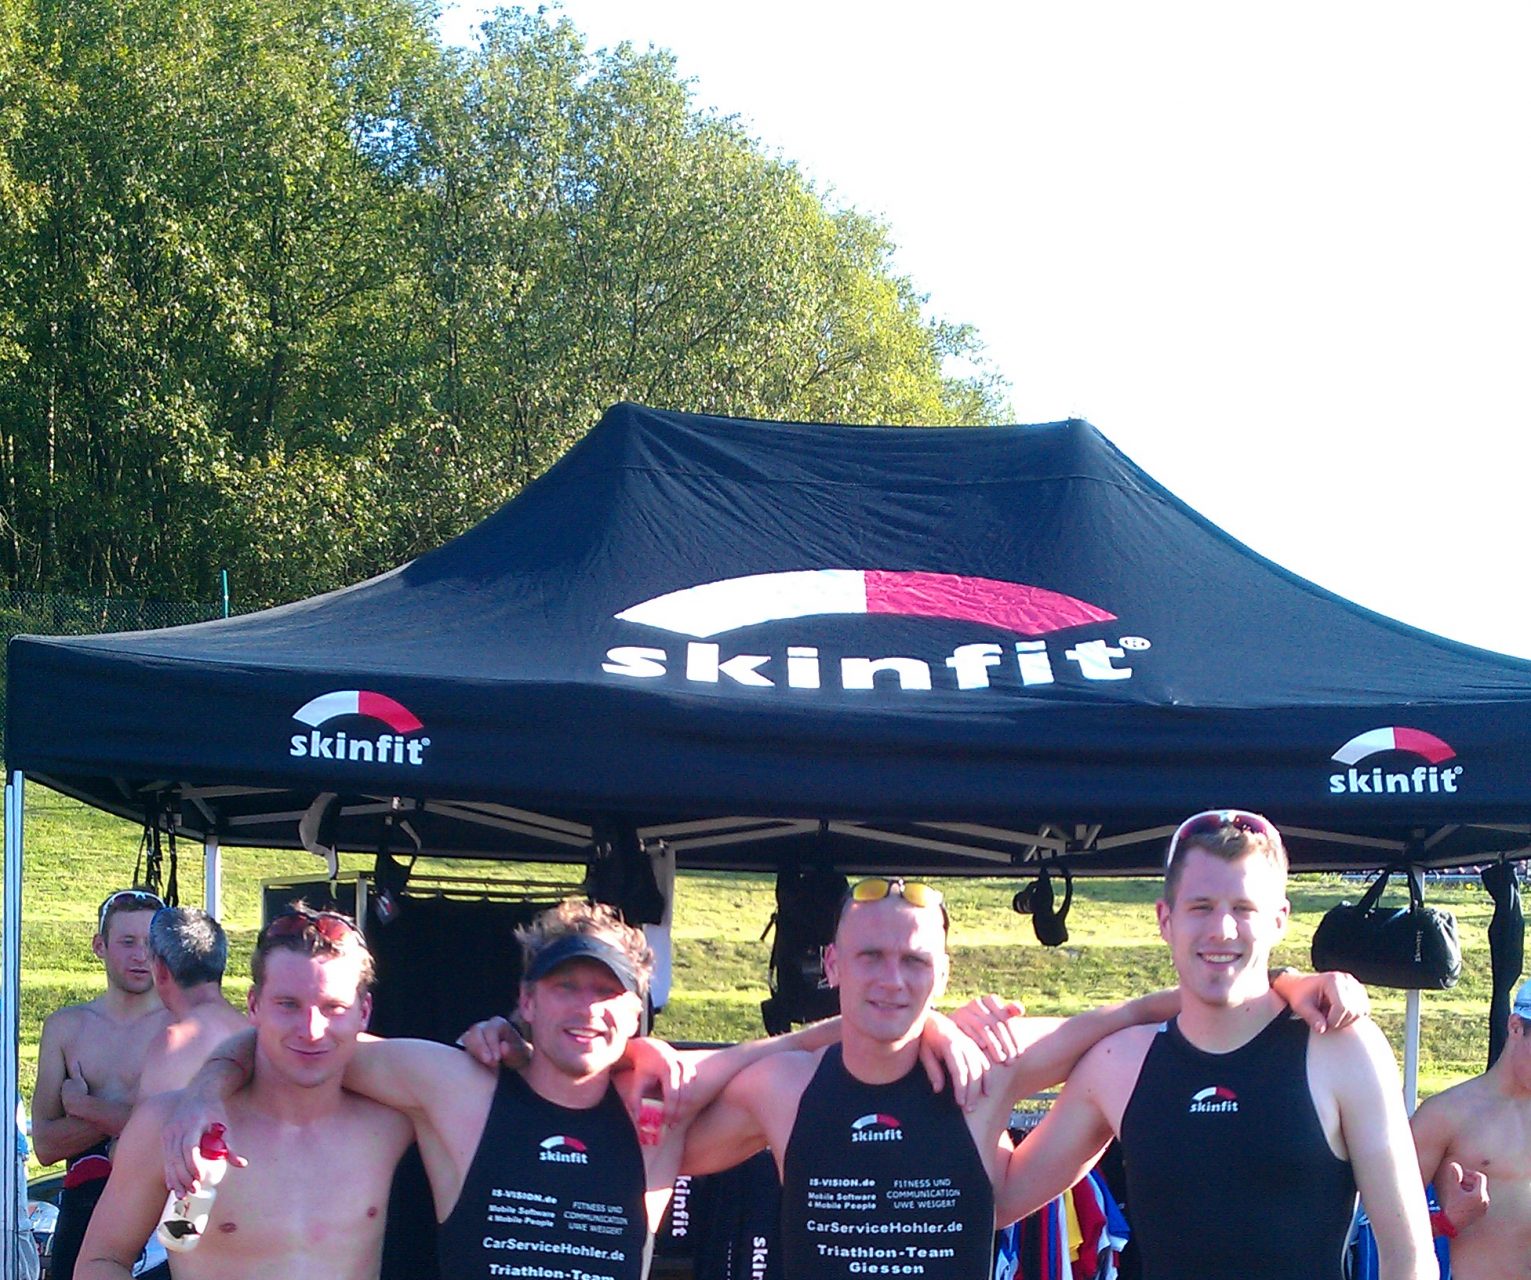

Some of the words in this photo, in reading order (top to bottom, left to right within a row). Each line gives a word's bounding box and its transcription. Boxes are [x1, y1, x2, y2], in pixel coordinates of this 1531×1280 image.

[1189, 1100, 1239, 1113] skinfit
[851, 1128, 904, 1143] skinfit
[539, 1150, 589, 1164] skinfit
[809, 1178, 876, 1187] IS-VISION.de
[893, 1179, 931, 1188] FITNESS
[808, 1192, 834, 1201] Mobile
[836, 1192, 877, 1201] Software
[886, 1188, 961, 1200] COMMUNICATION
[671, 1175, 692, 1237] kinfit
[814, 1202, 842, 1210] Mobile
[844, 1202, 877, 1211] People
[893, 1200, 915, 1209] UWE
[806, 1219, 963, 1234] CarServiceHohler.de
[482, 1236, 626, 1262] CarServiceHohler.de
[817, 1243, 955, 1258] Triathlon-Team
[849, 1261, 925, 1275] Giessen
